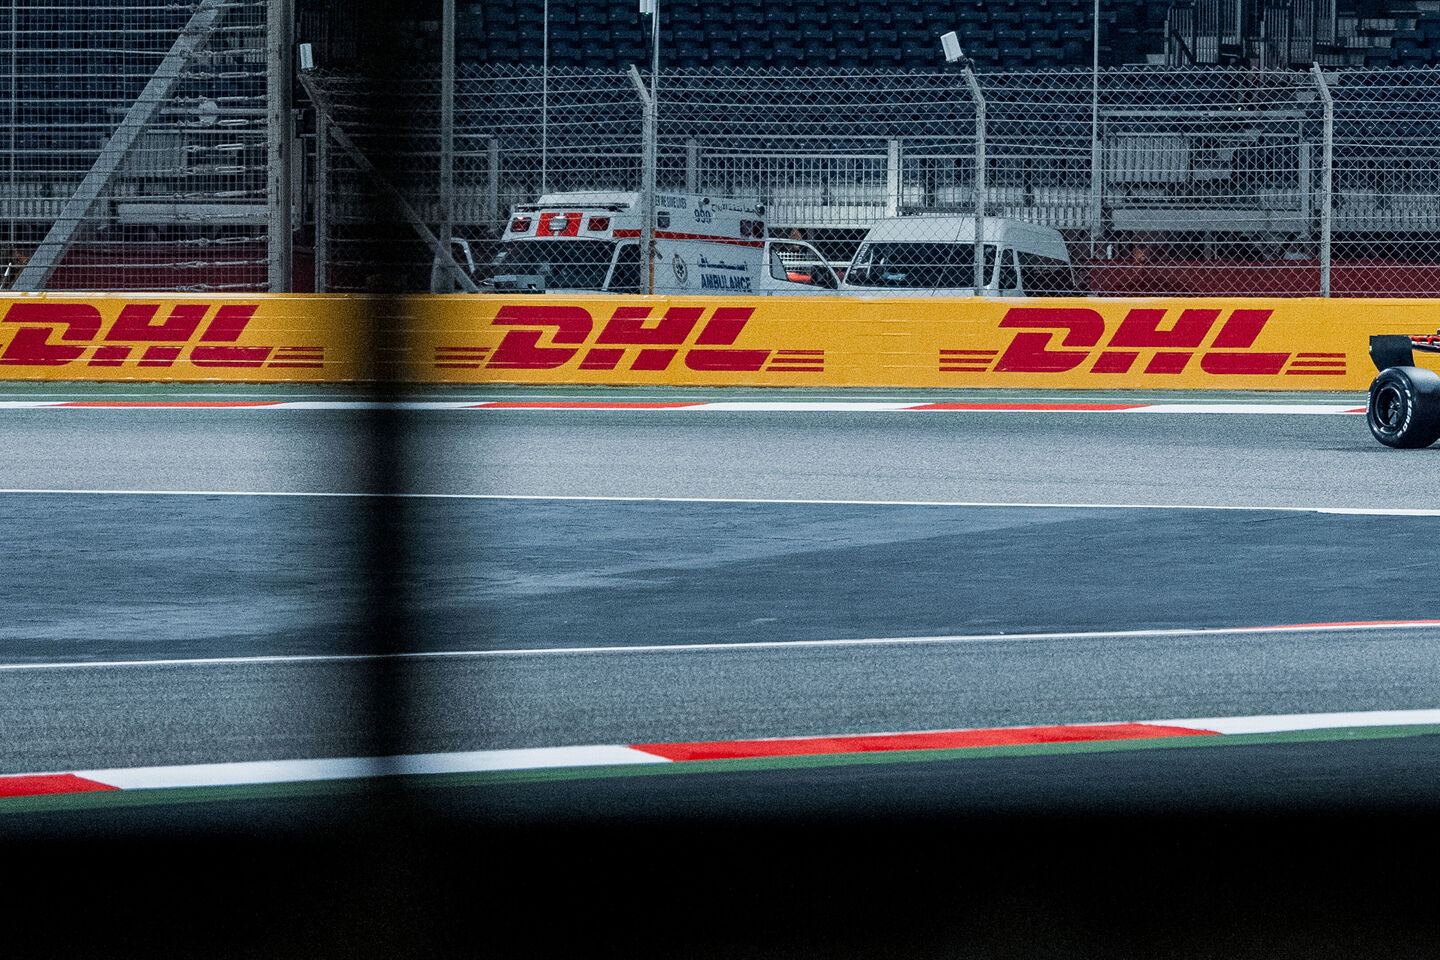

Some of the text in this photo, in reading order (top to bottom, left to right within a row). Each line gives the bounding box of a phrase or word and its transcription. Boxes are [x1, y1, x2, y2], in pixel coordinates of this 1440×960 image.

[693, 208, 712, 224] 999
[700, 273, 753, 293] AMBULANCE
[0, 303, 274, 367] DHL
[484, 305, 771, 372] DHL
[993, 307, 1290, 375] DHL
